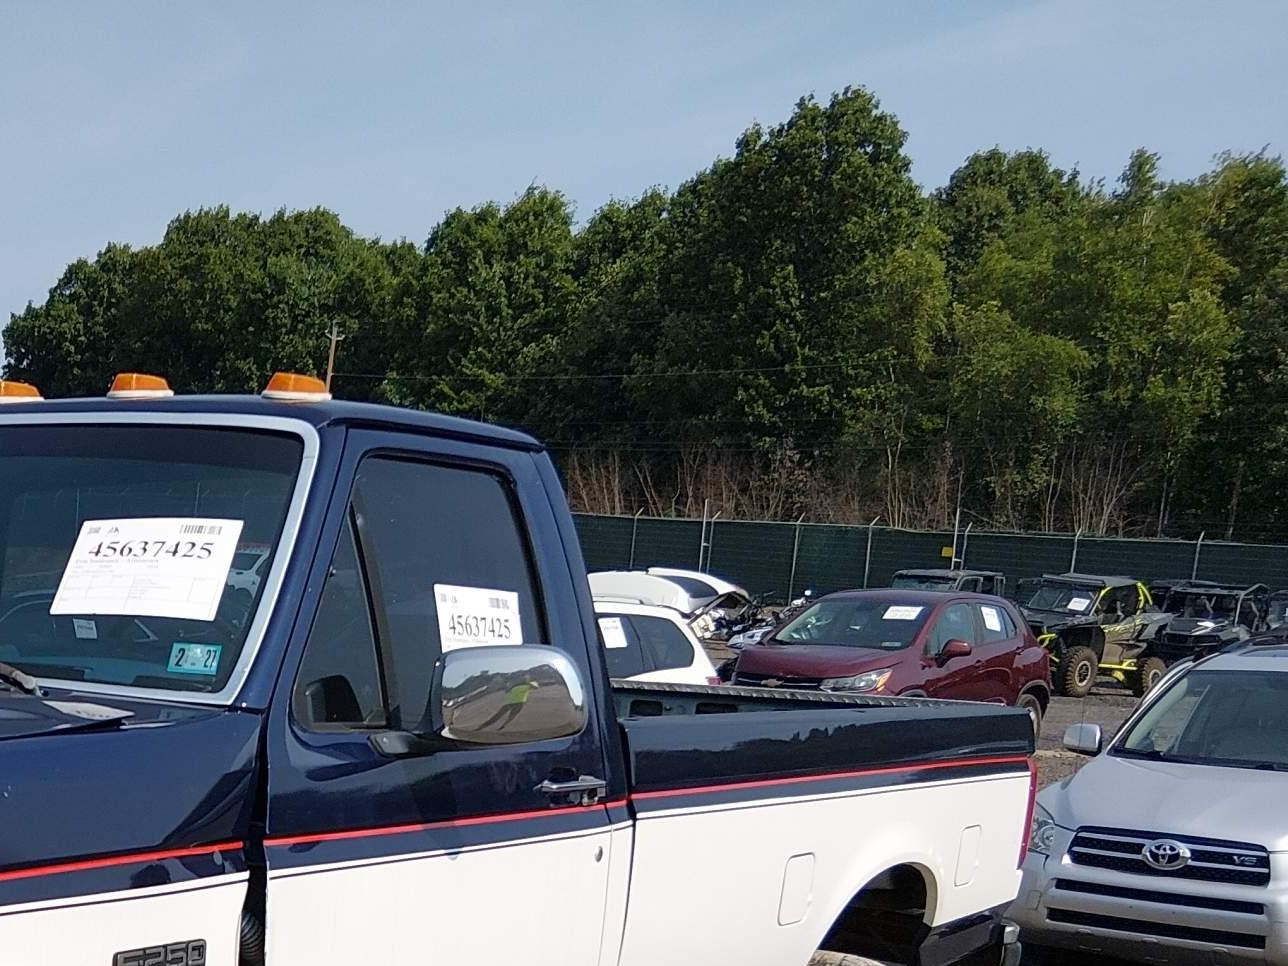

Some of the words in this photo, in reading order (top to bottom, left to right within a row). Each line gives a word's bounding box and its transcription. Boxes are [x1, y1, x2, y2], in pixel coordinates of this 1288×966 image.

[89, 541, 214, 559] 45637425
[449, 614, 511, 639] 45637425
[175, 647, 186, 667] 2
[204, 649, 217, 671] 27
